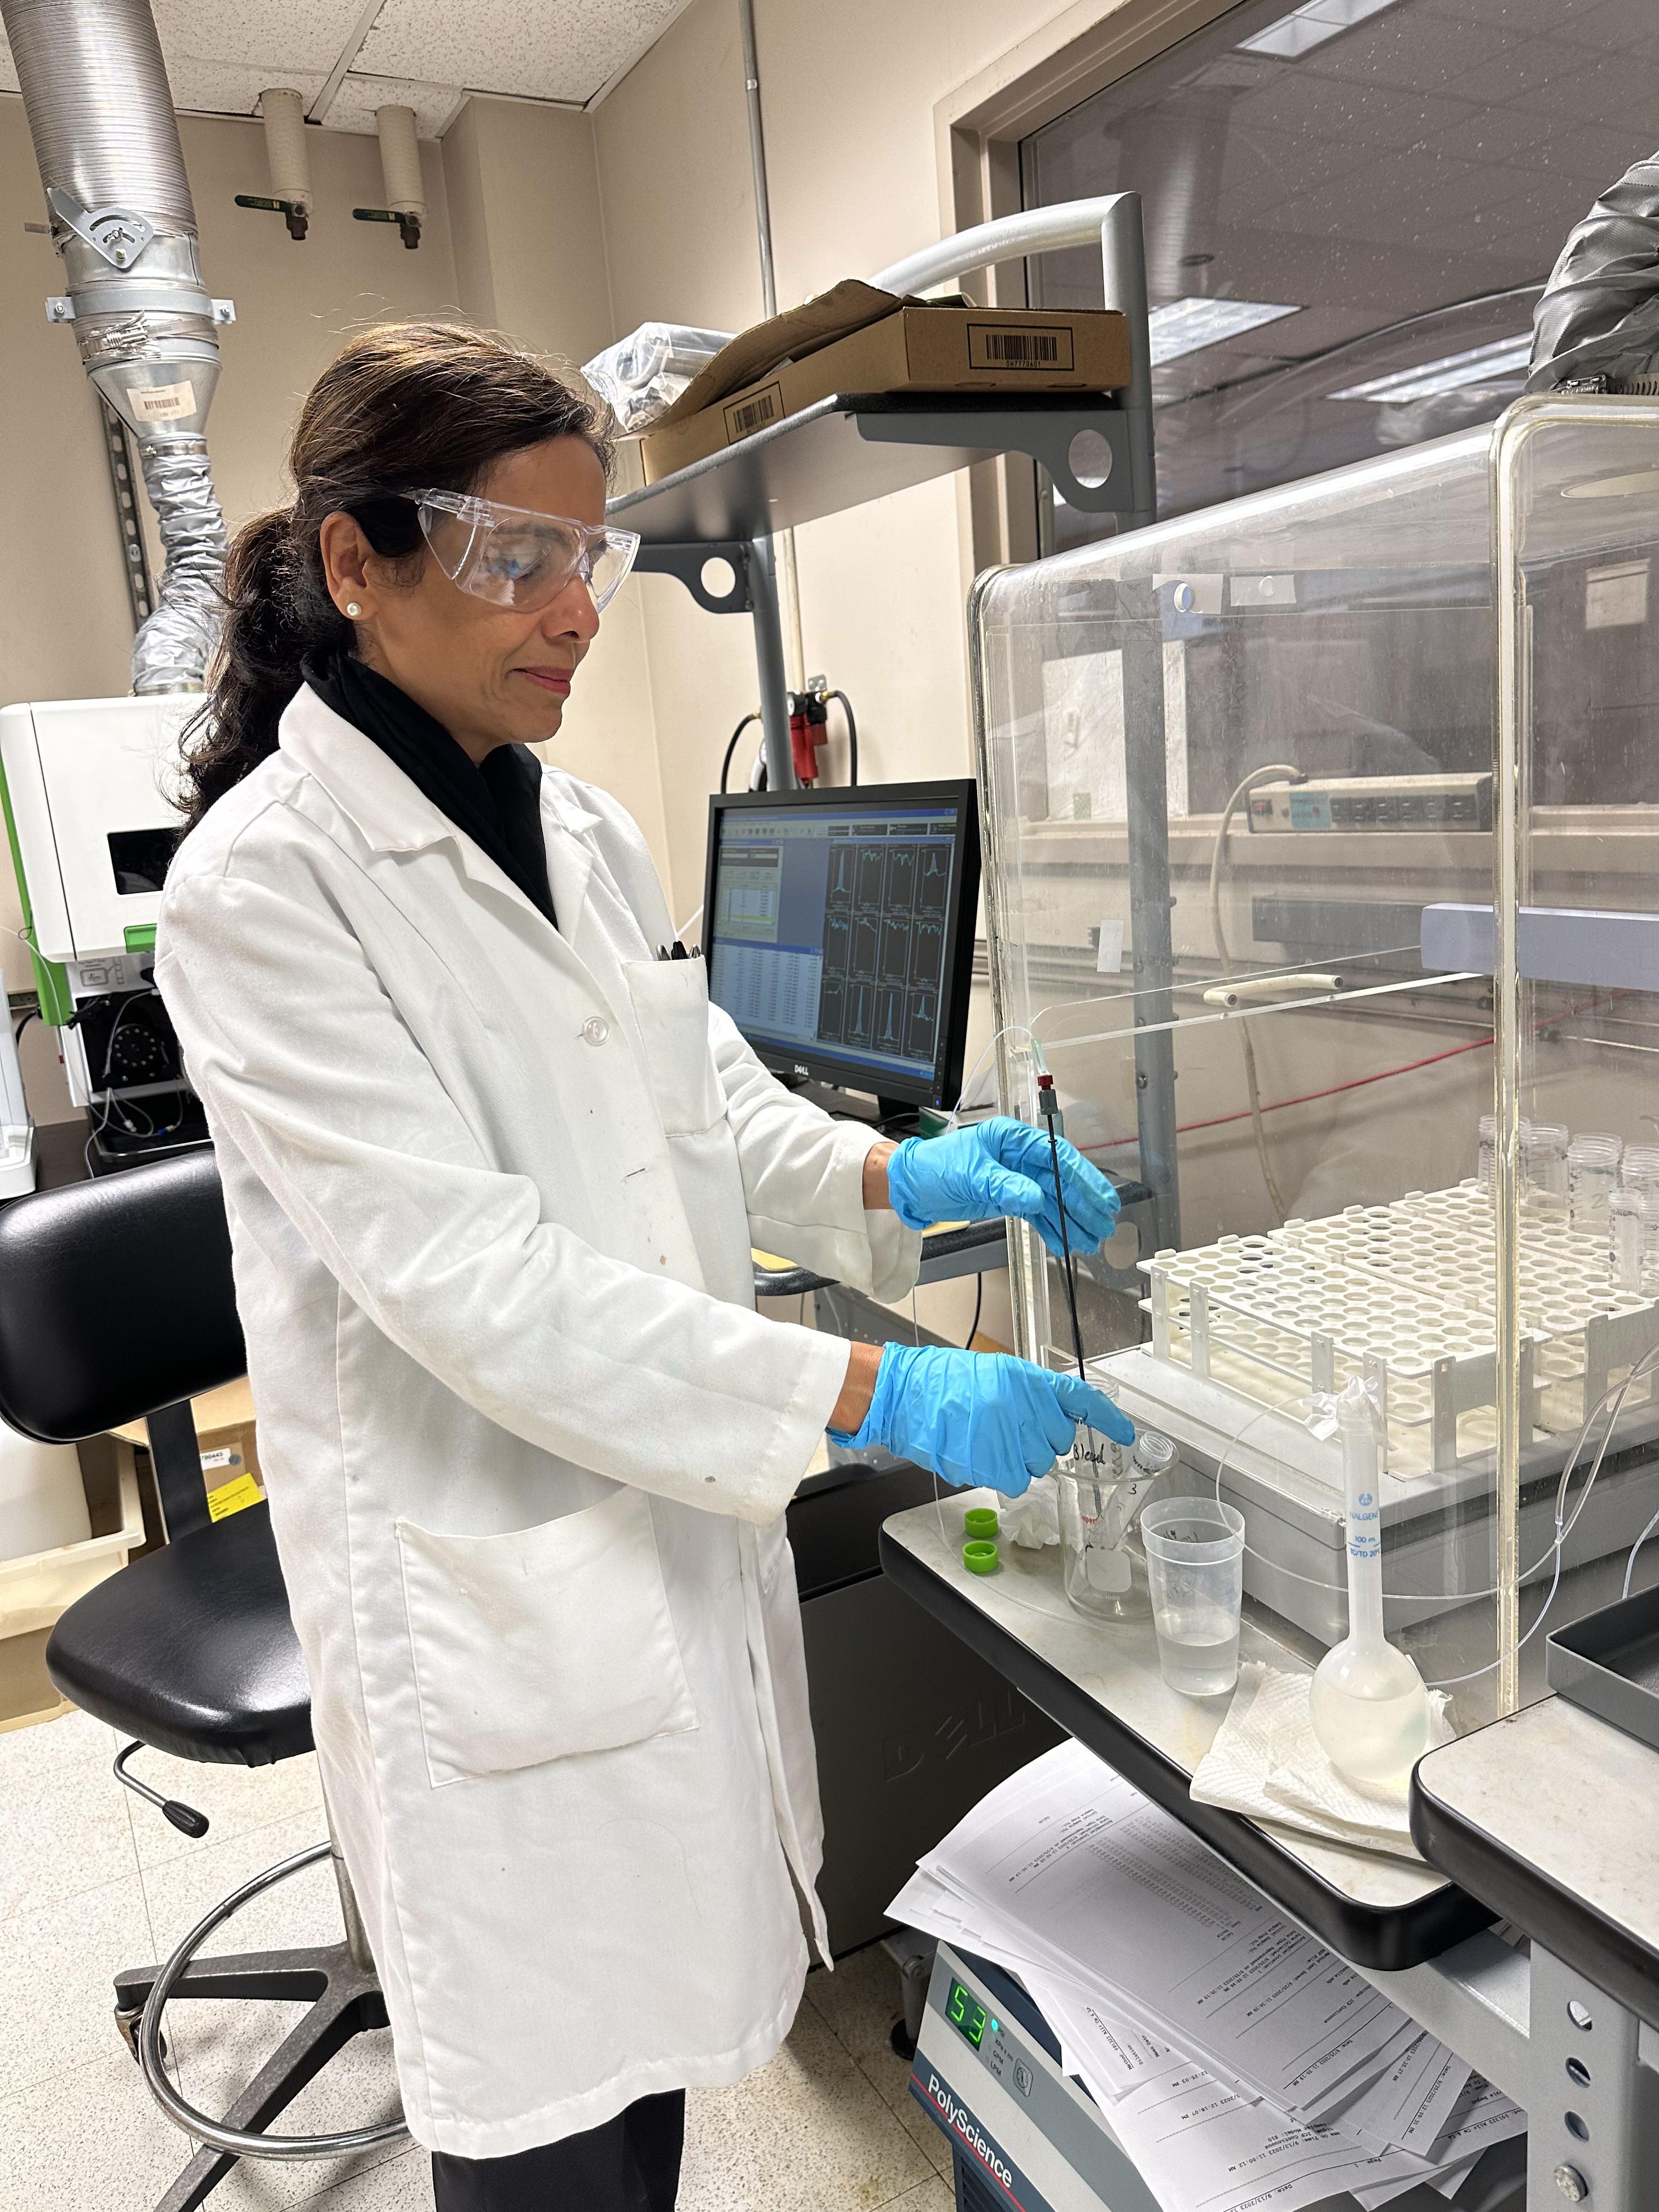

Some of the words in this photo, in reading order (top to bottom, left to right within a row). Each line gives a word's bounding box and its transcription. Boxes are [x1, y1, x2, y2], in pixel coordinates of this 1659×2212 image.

[794, 1064, 809, 1075] DELL
[1127, 1483, 1137, 1495] 3
[882, 1689, 1026, 1783] DELL
[950, 1985, 987, 2042] 53
[990, 2060, 1001, 2077] LPM
[928, 2073, 1013, 2188] PolyScience
[1240, 2193, 1272, 2210] 9/13/2023
